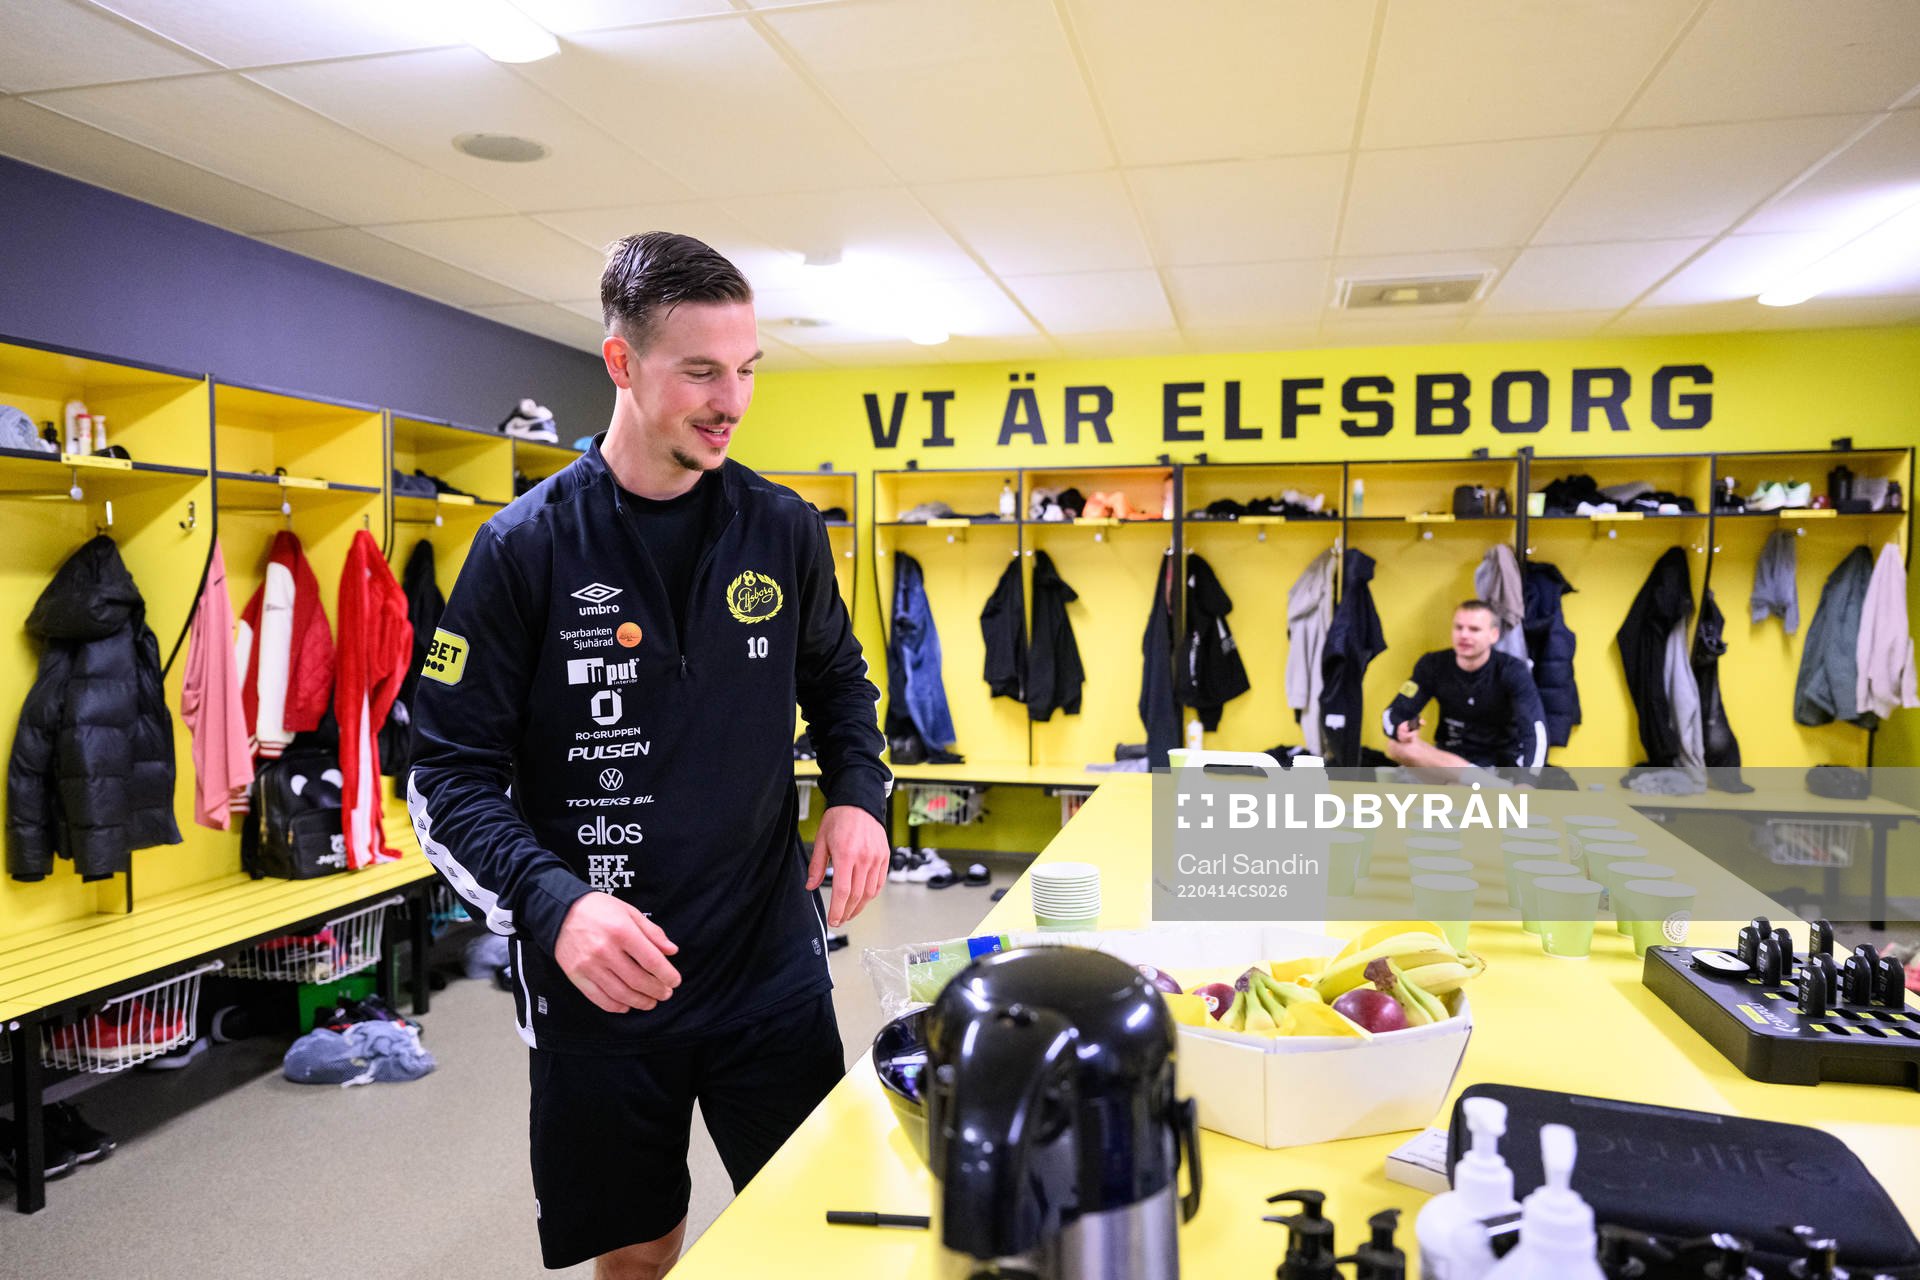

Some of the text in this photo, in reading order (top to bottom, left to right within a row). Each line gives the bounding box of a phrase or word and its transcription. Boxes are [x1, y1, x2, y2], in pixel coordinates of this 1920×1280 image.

[863, 364, 1714, 448] VI ÄR ELFSBORG
[579, 604, 620, 616] umbro
[560, 627, 613, 641] Sparbanken
[573, 637, 614, 650] Sjuhärad
[747, 636, 769, 659] 10
[575, 726, 641, 740] RO-GRUPPEN
[567, 741, 651, 762] PULSEN
[566, 795, 655, 807] TOVEKS BIL
[577, 815, 644, 845] ellos
[588, 854, 629, 871] EFF
[588, 871, 635, 888] EKT
